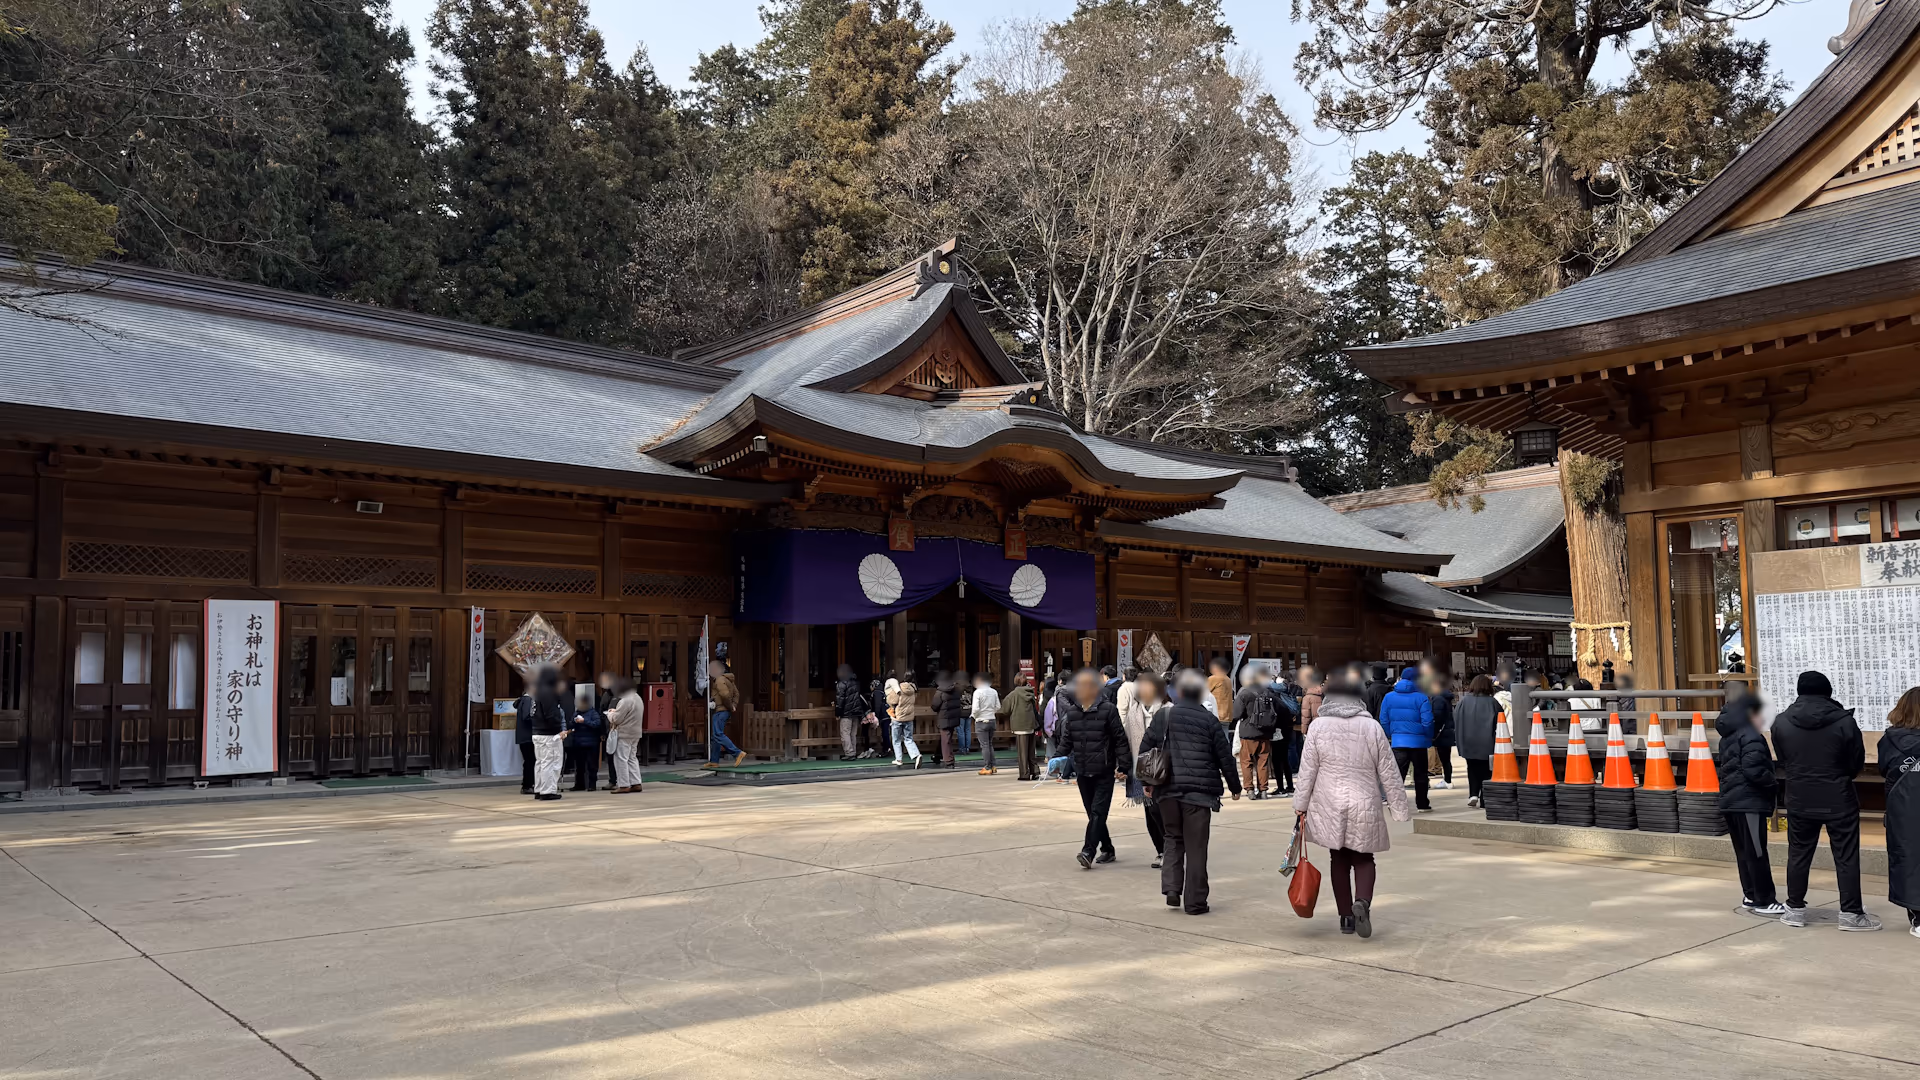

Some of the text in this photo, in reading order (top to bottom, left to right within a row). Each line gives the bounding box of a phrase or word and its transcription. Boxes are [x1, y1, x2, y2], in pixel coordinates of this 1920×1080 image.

[1007, 532, 1025, 557] 正
[244, 613, 263, 687] お神札は
[224, 669, 245, 761] 家の守り神
